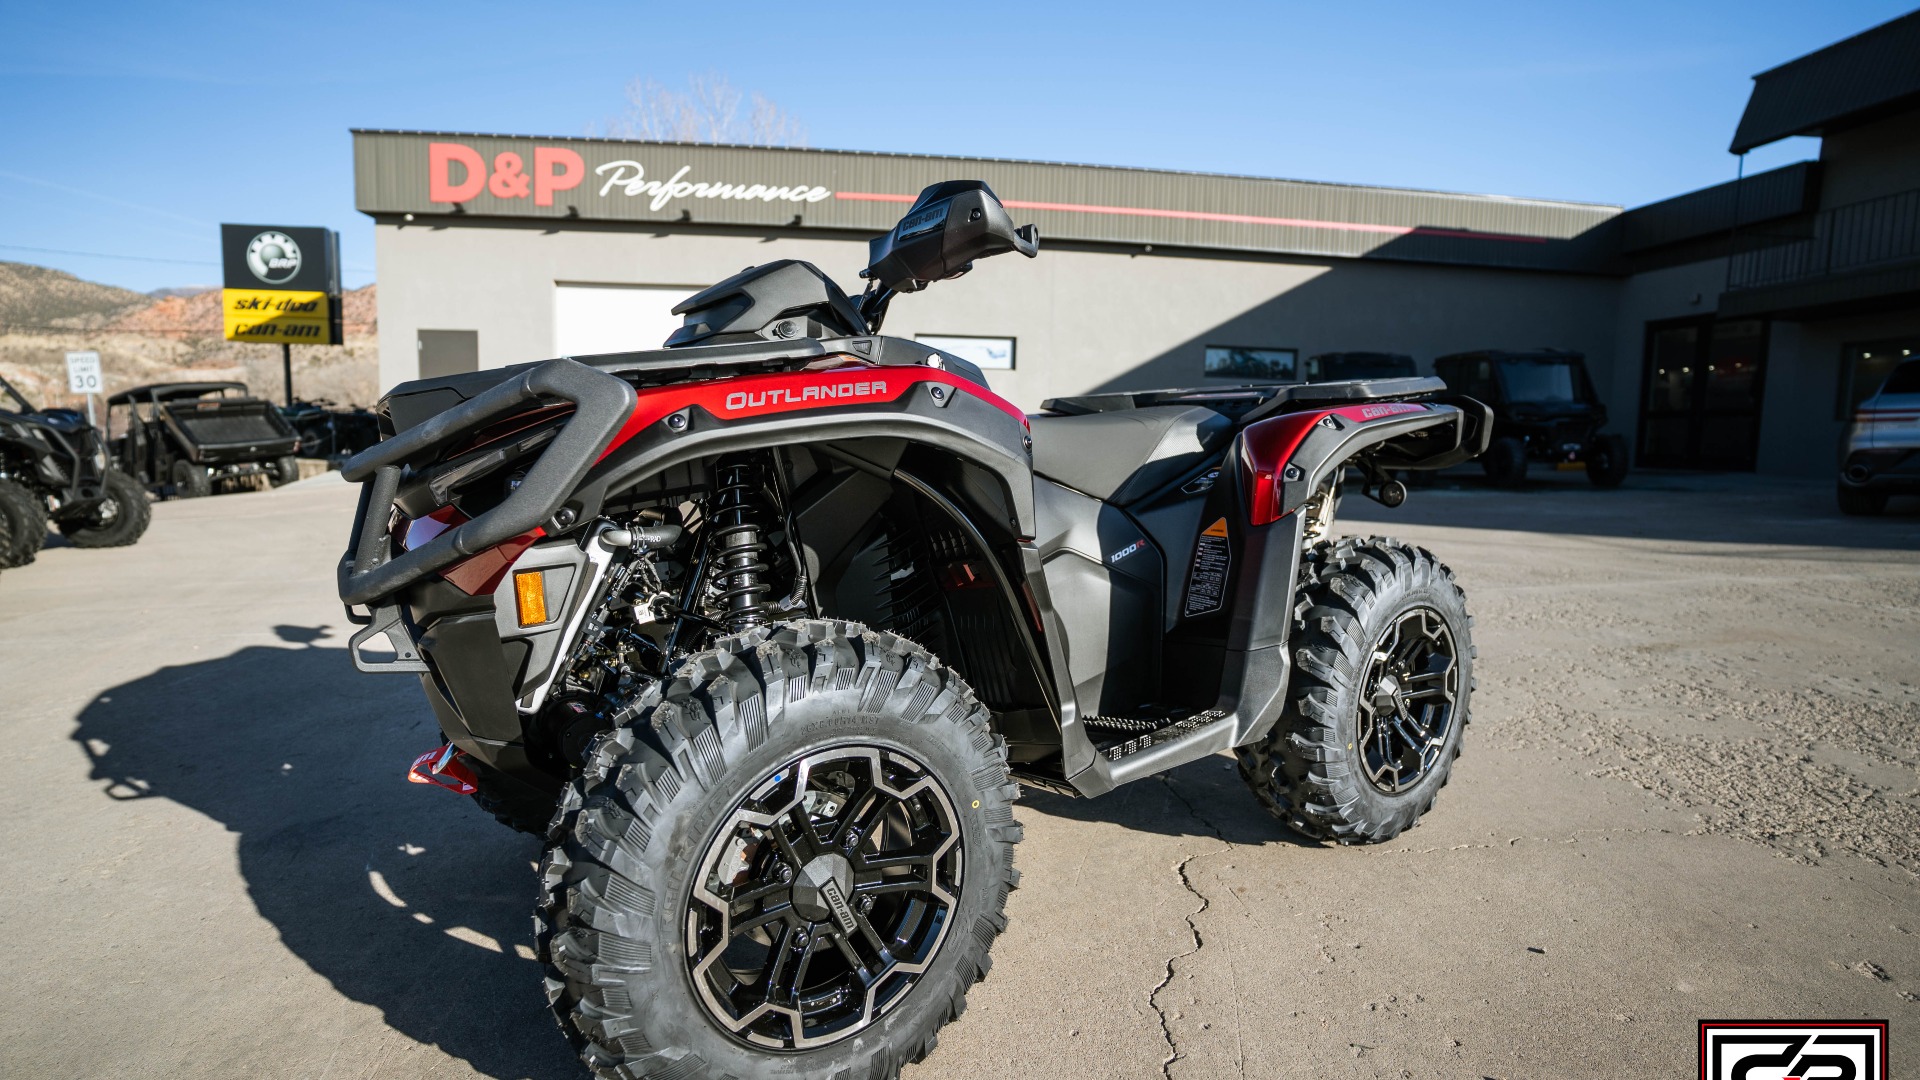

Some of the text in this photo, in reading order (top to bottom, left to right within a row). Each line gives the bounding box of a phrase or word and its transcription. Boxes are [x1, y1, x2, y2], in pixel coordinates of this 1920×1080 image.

[429, 142, 831, 211] D&P Performance
[902, 207, 944, 231] can-am
[268, 257, 298, 269] BRP
[234, 297, 318, 312] ski-doo
[234, 324, 321, 337] can-am
[75, 375, 97, 388] 30
[725, 380, 887, 411] OUTLANDER
[1111, 538, 1146, 563] 1000R
[827, 888, 855, 929] can-am
